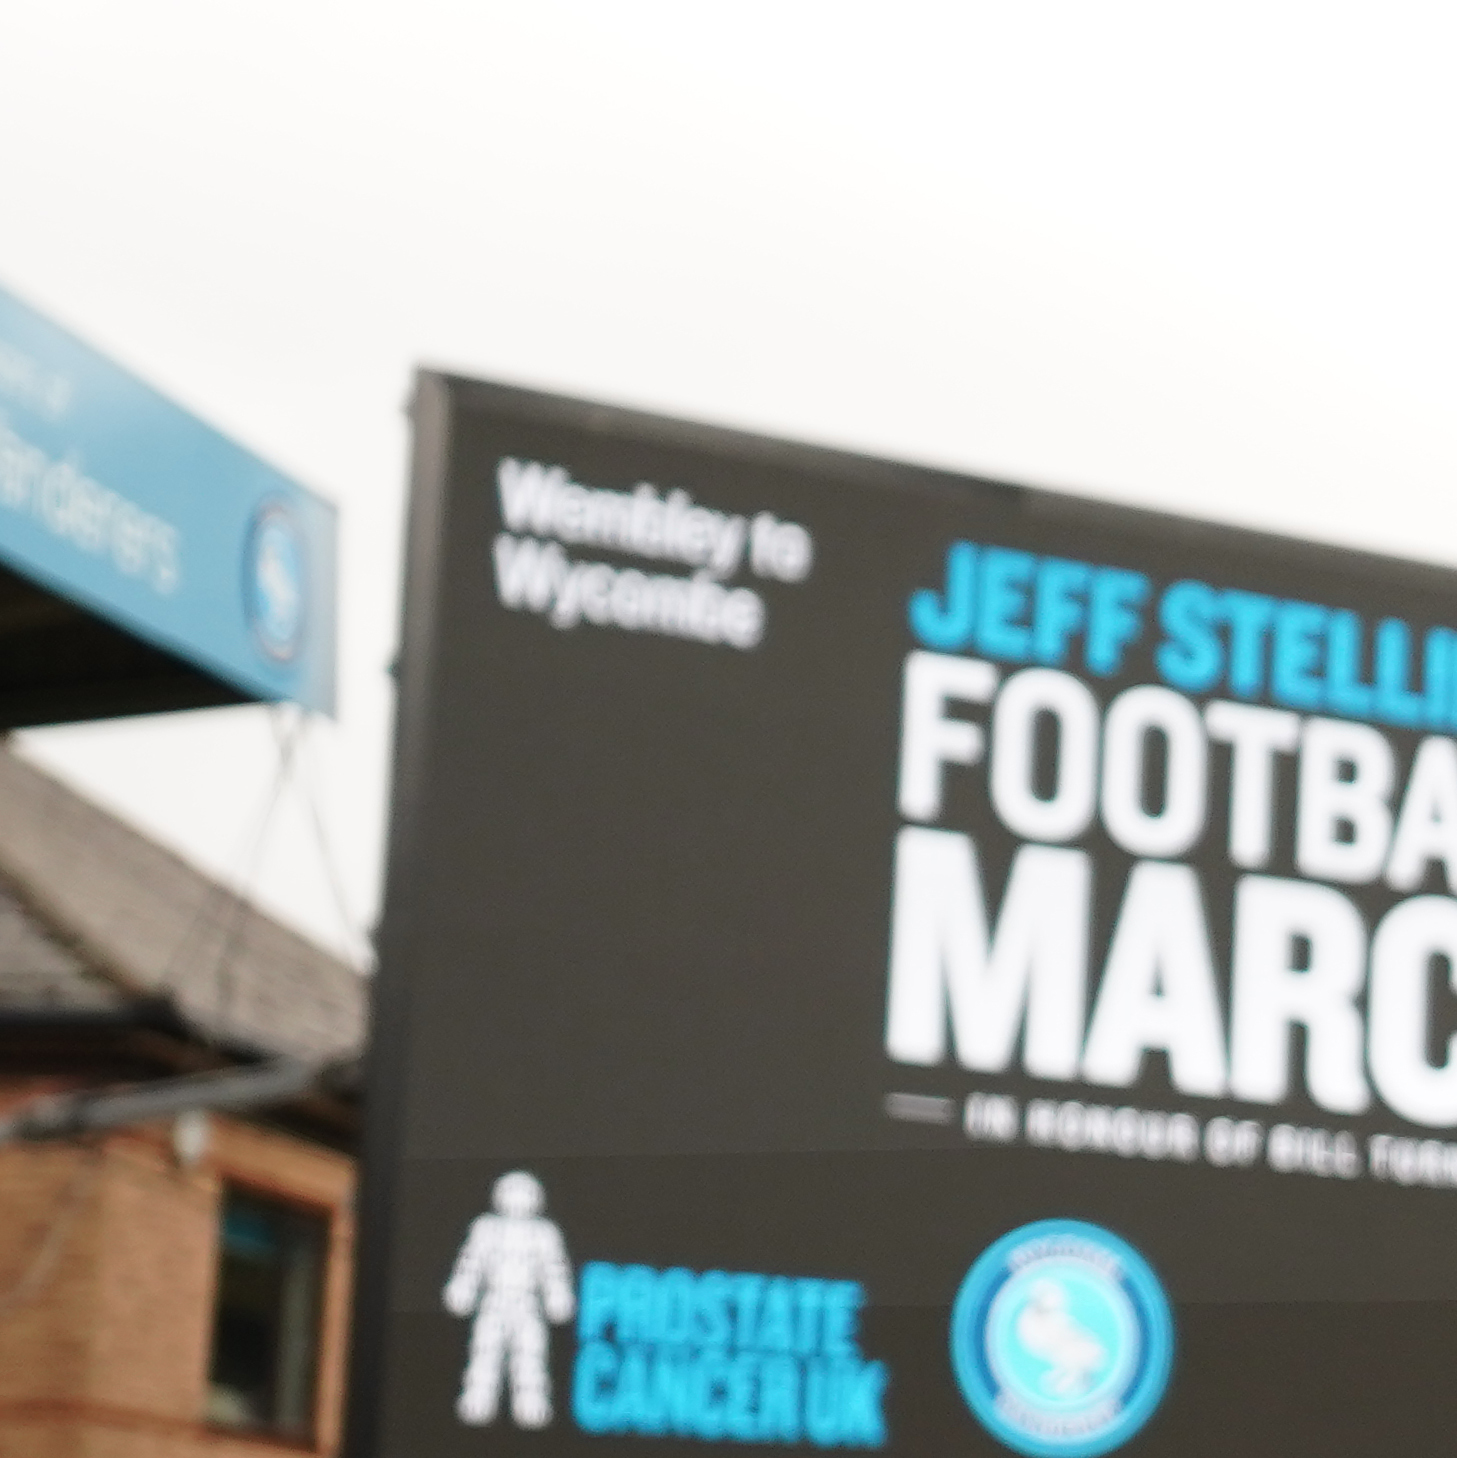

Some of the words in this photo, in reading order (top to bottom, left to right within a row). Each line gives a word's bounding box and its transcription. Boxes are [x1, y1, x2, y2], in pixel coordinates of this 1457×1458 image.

[498, 457, 747, 581] Wembley
[750, 511, 812, 582] to
[494, 533, 766, 650] Wycombe
[909, 540, 1150, 676] JEFF
[964, 1093, 1020, 1143] IN
[1025, 1098, 1199, 1163] HONOUR
[1204, 1116, 1262, 1168] OF
[1267, 1123, 1361, 1180] BILL
[578, 1261, 867, 1356] PROSTATE
[571, 1341, 801, 1443] CANCER
[803, 1355, 890, 1449] UK
